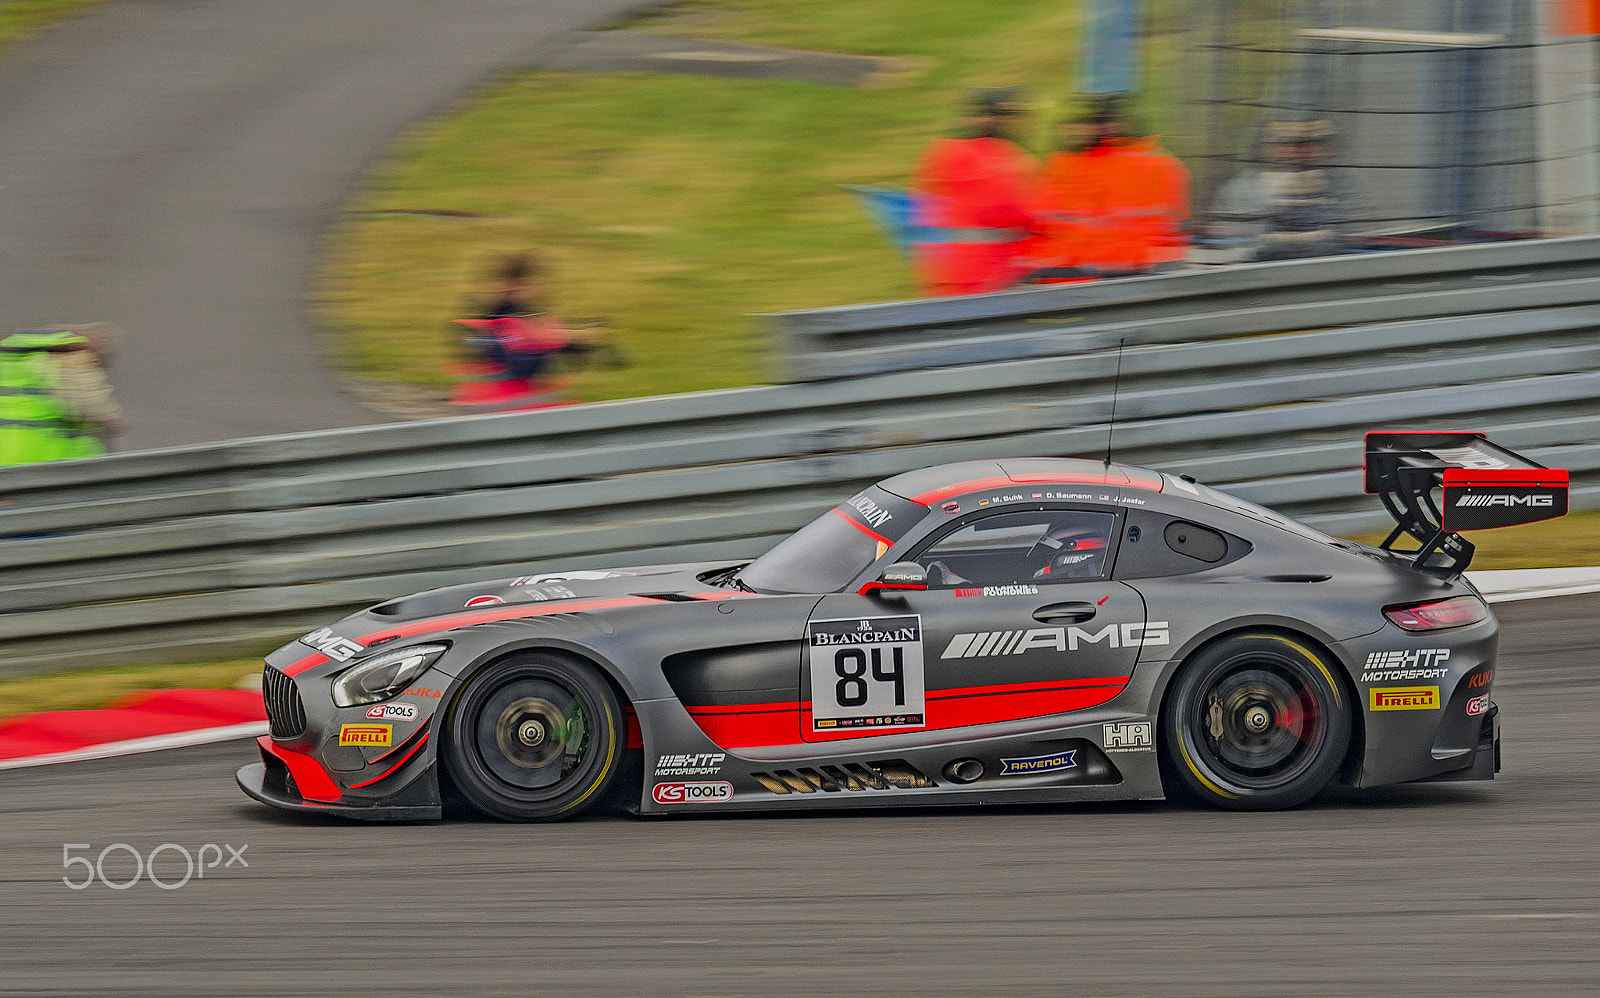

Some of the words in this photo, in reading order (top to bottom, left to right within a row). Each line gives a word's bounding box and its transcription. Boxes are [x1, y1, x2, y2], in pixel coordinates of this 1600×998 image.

[1056, 492, 1092, 500] Baumann
[1486, 494, 1554, 507] AMG
[815, 627, 916, 646] BLANCPAIN
[1012, 621, 1170, 655] AMG
[300, 627, 365, 663] MG
[1400, 648, 1451, 669] HTP
[834, 646, 906, 708] 84
[1360, 668, 1449, 682] MOTORSPORT
[1376, 690, 1434, 706] PIRELLI
[385, 706, 413, 717] TOOLS
[341, 727, 388, 743] PIRELLI
[1105, 724, 1150, 745] HA
[682, 753, 726, 767] HTP
[1011, 757, 1068, 770] RAVENOL
[654, 766, 721, 776] MOTORSPORT
[658, 785, 685, 800] KS
[684, 785, 728, 798] TOOLS
